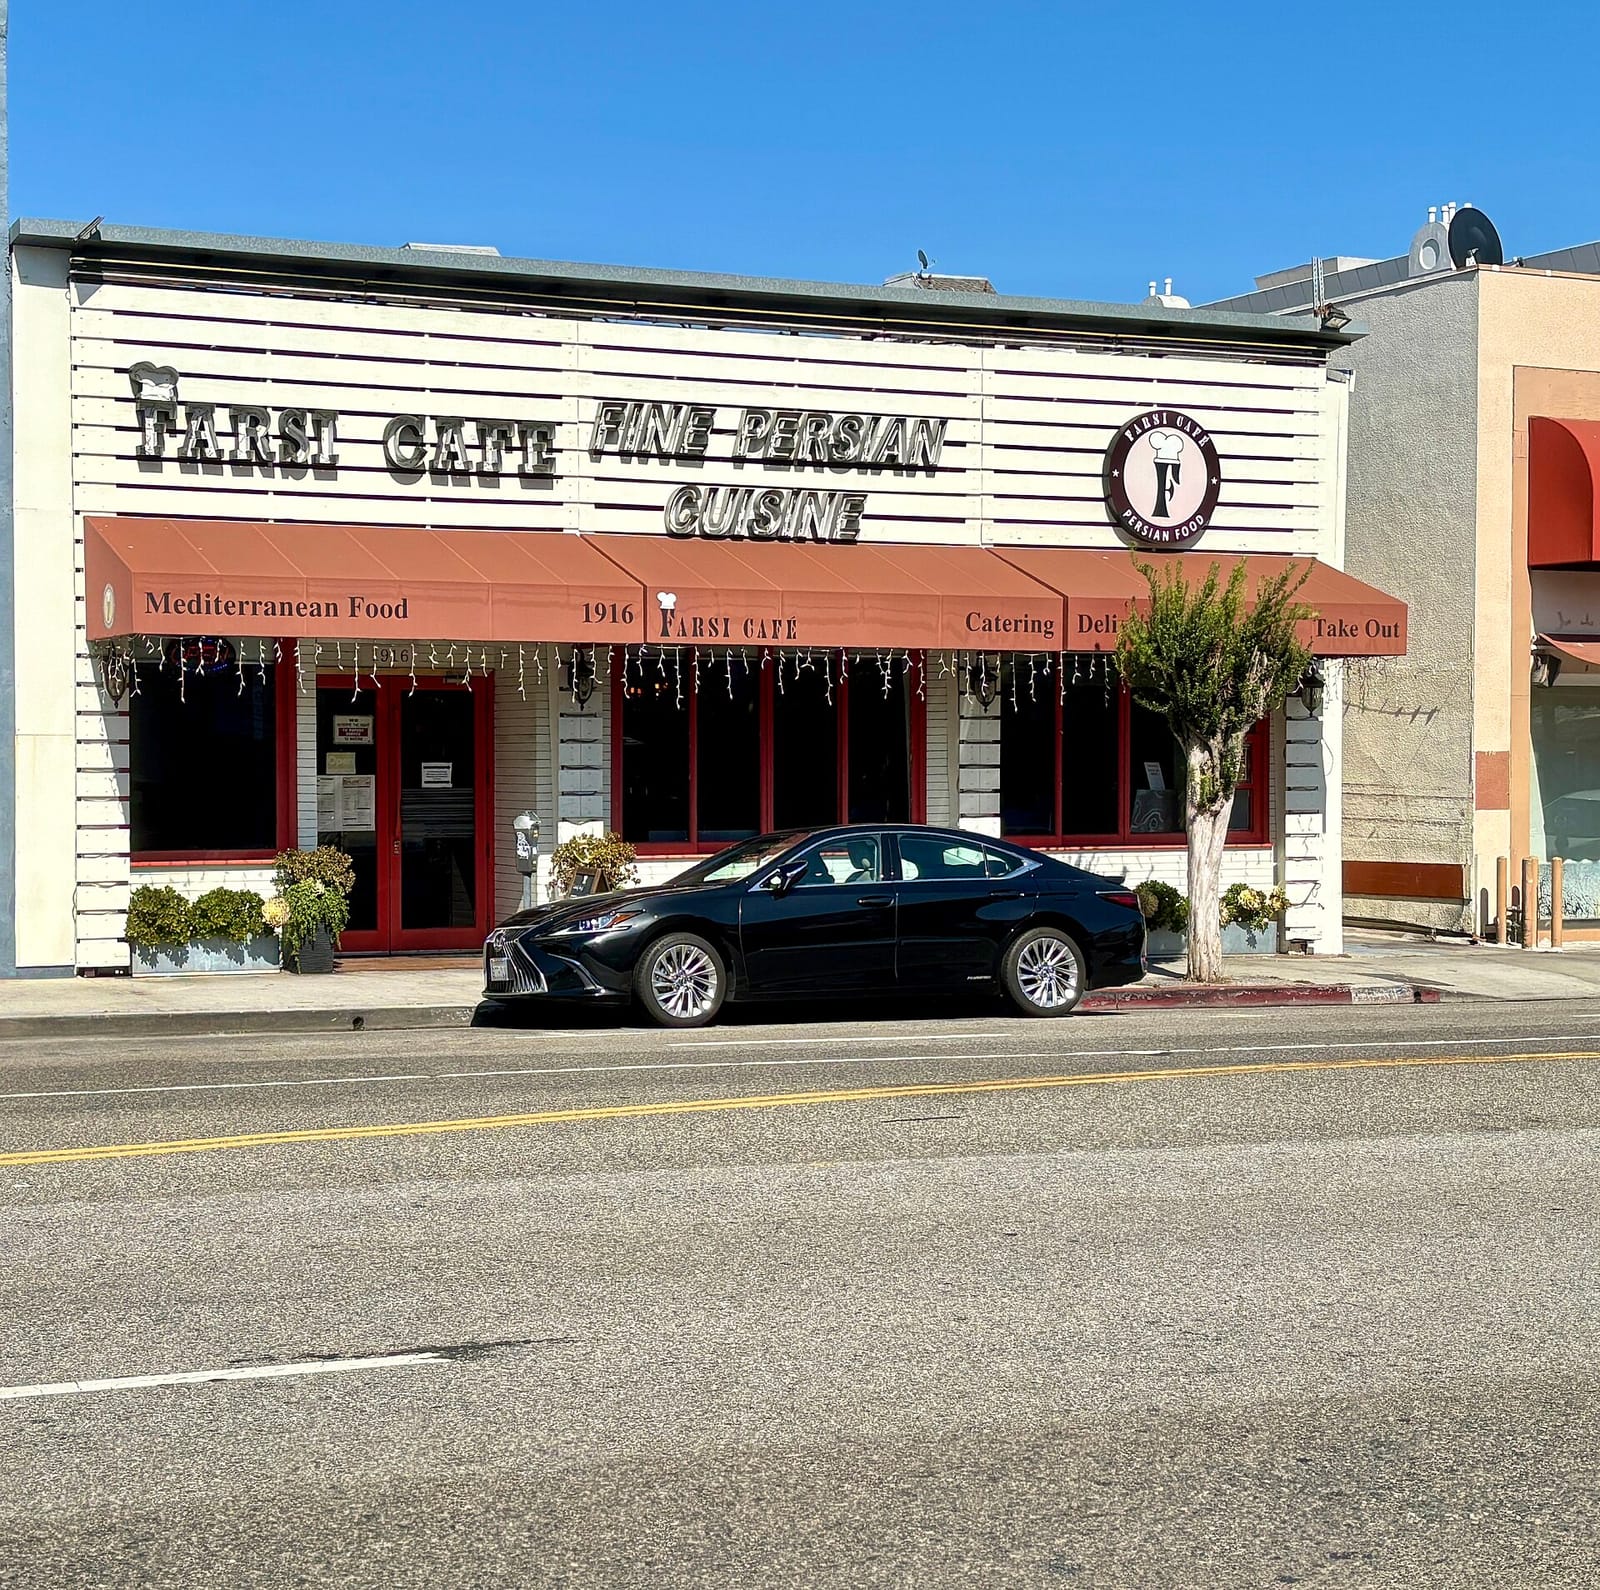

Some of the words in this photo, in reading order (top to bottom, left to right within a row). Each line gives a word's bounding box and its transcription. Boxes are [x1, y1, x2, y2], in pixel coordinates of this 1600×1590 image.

[134, 401, 340, 471] FARSI
[383, 414, 557, 479] CAFE
[588, 401, 717, 460] FINE
[733, 408, 949, 472] PERSIAN
[1124, 412, 1167, 442] FARSI
[663, 484, 869, 543] CUISINE
[1122, 508, 1169, 541] PERSIAN
[1174, 515, 1204, 540] FOOD
[144, 591, 339, 618] Mediterranean
[347, 596, 409, 620] Food
[582, 602, 634, 624] 1916
[659, 608, 730, 638] FARSI
[742, 615, 798, 640] CAFÉ
[965, 612, 1054, 639] Catering
[1313, 618, 1358, 638] Take
[1365, 618, 1400, 638] Out
